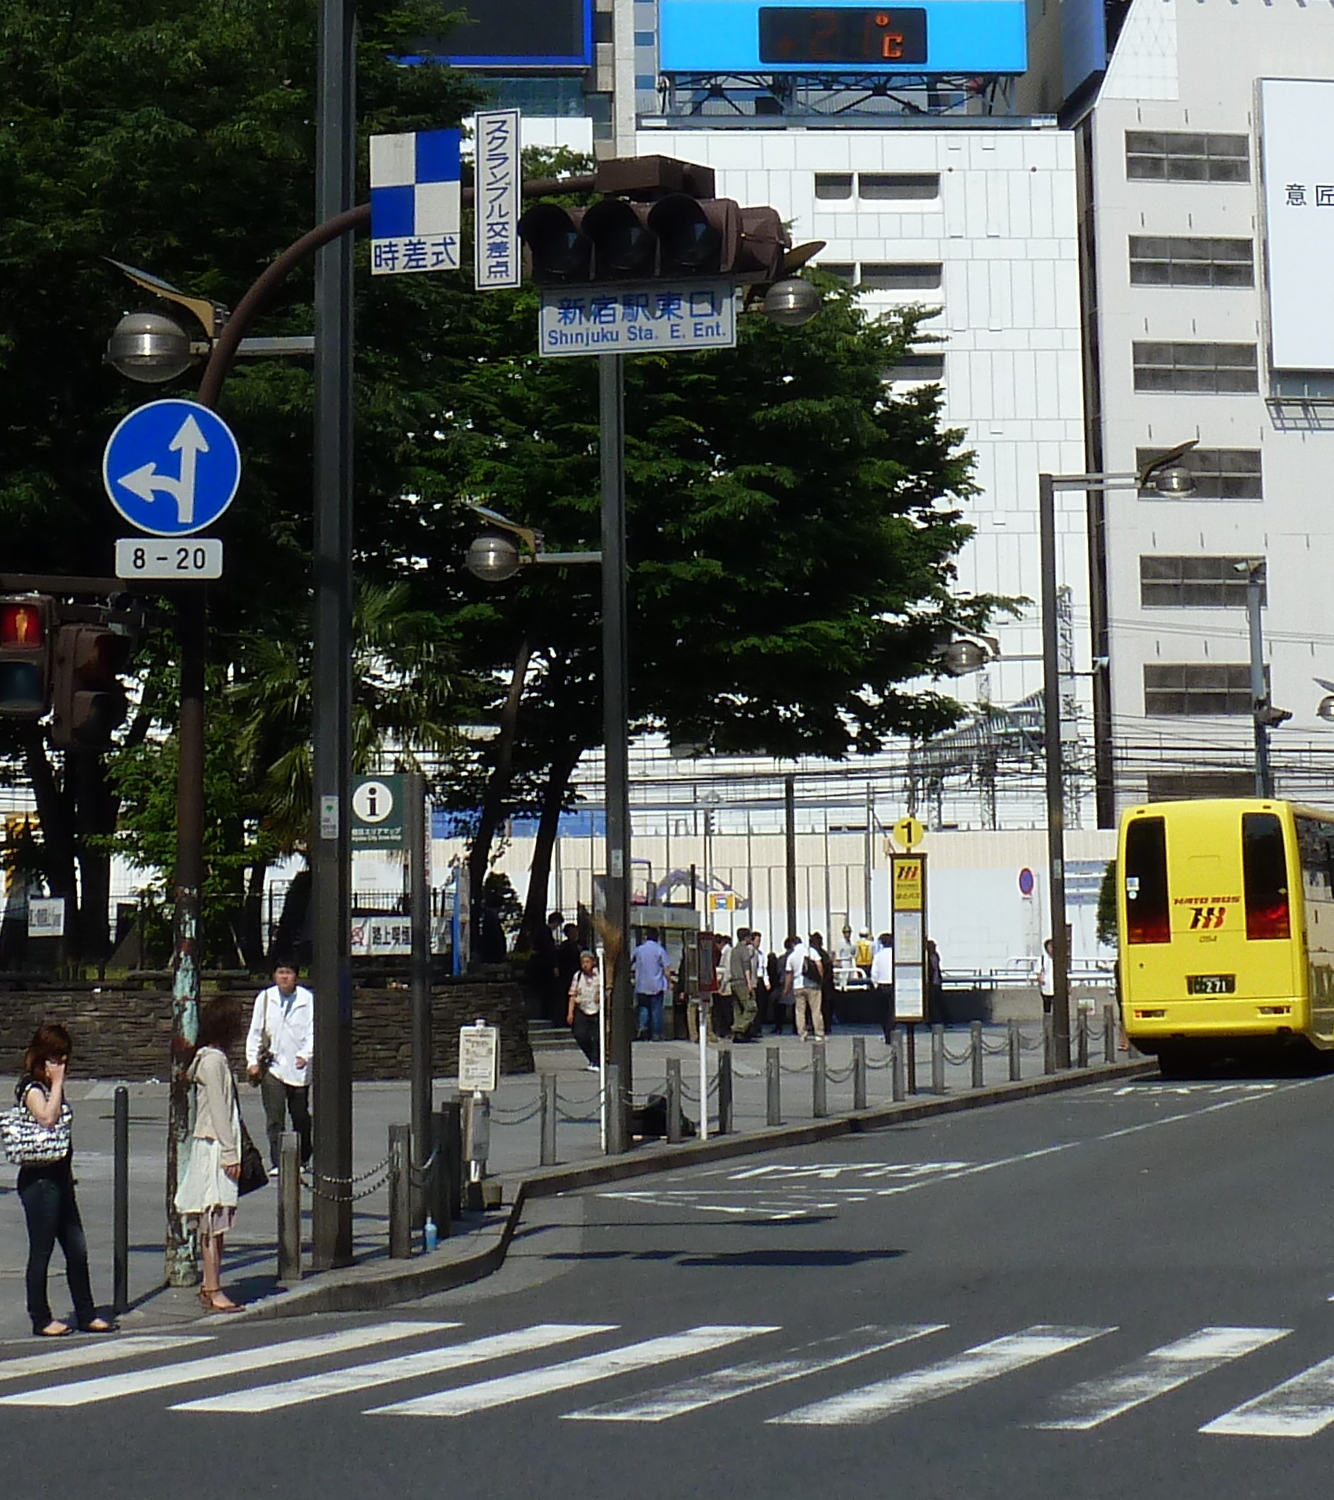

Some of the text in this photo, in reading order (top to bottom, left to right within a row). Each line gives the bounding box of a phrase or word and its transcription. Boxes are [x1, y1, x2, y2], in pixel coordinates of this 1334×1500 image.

[484, 118, 511, 279] スクランブル交差点
[373, 236, 457, 271] 時差式
[557, 290, 717, 328] 新宿駅東口
[547, 321, 727, 348] Shinjuku Sta. E. Ent.
[901, 820, 913, 844] 1
